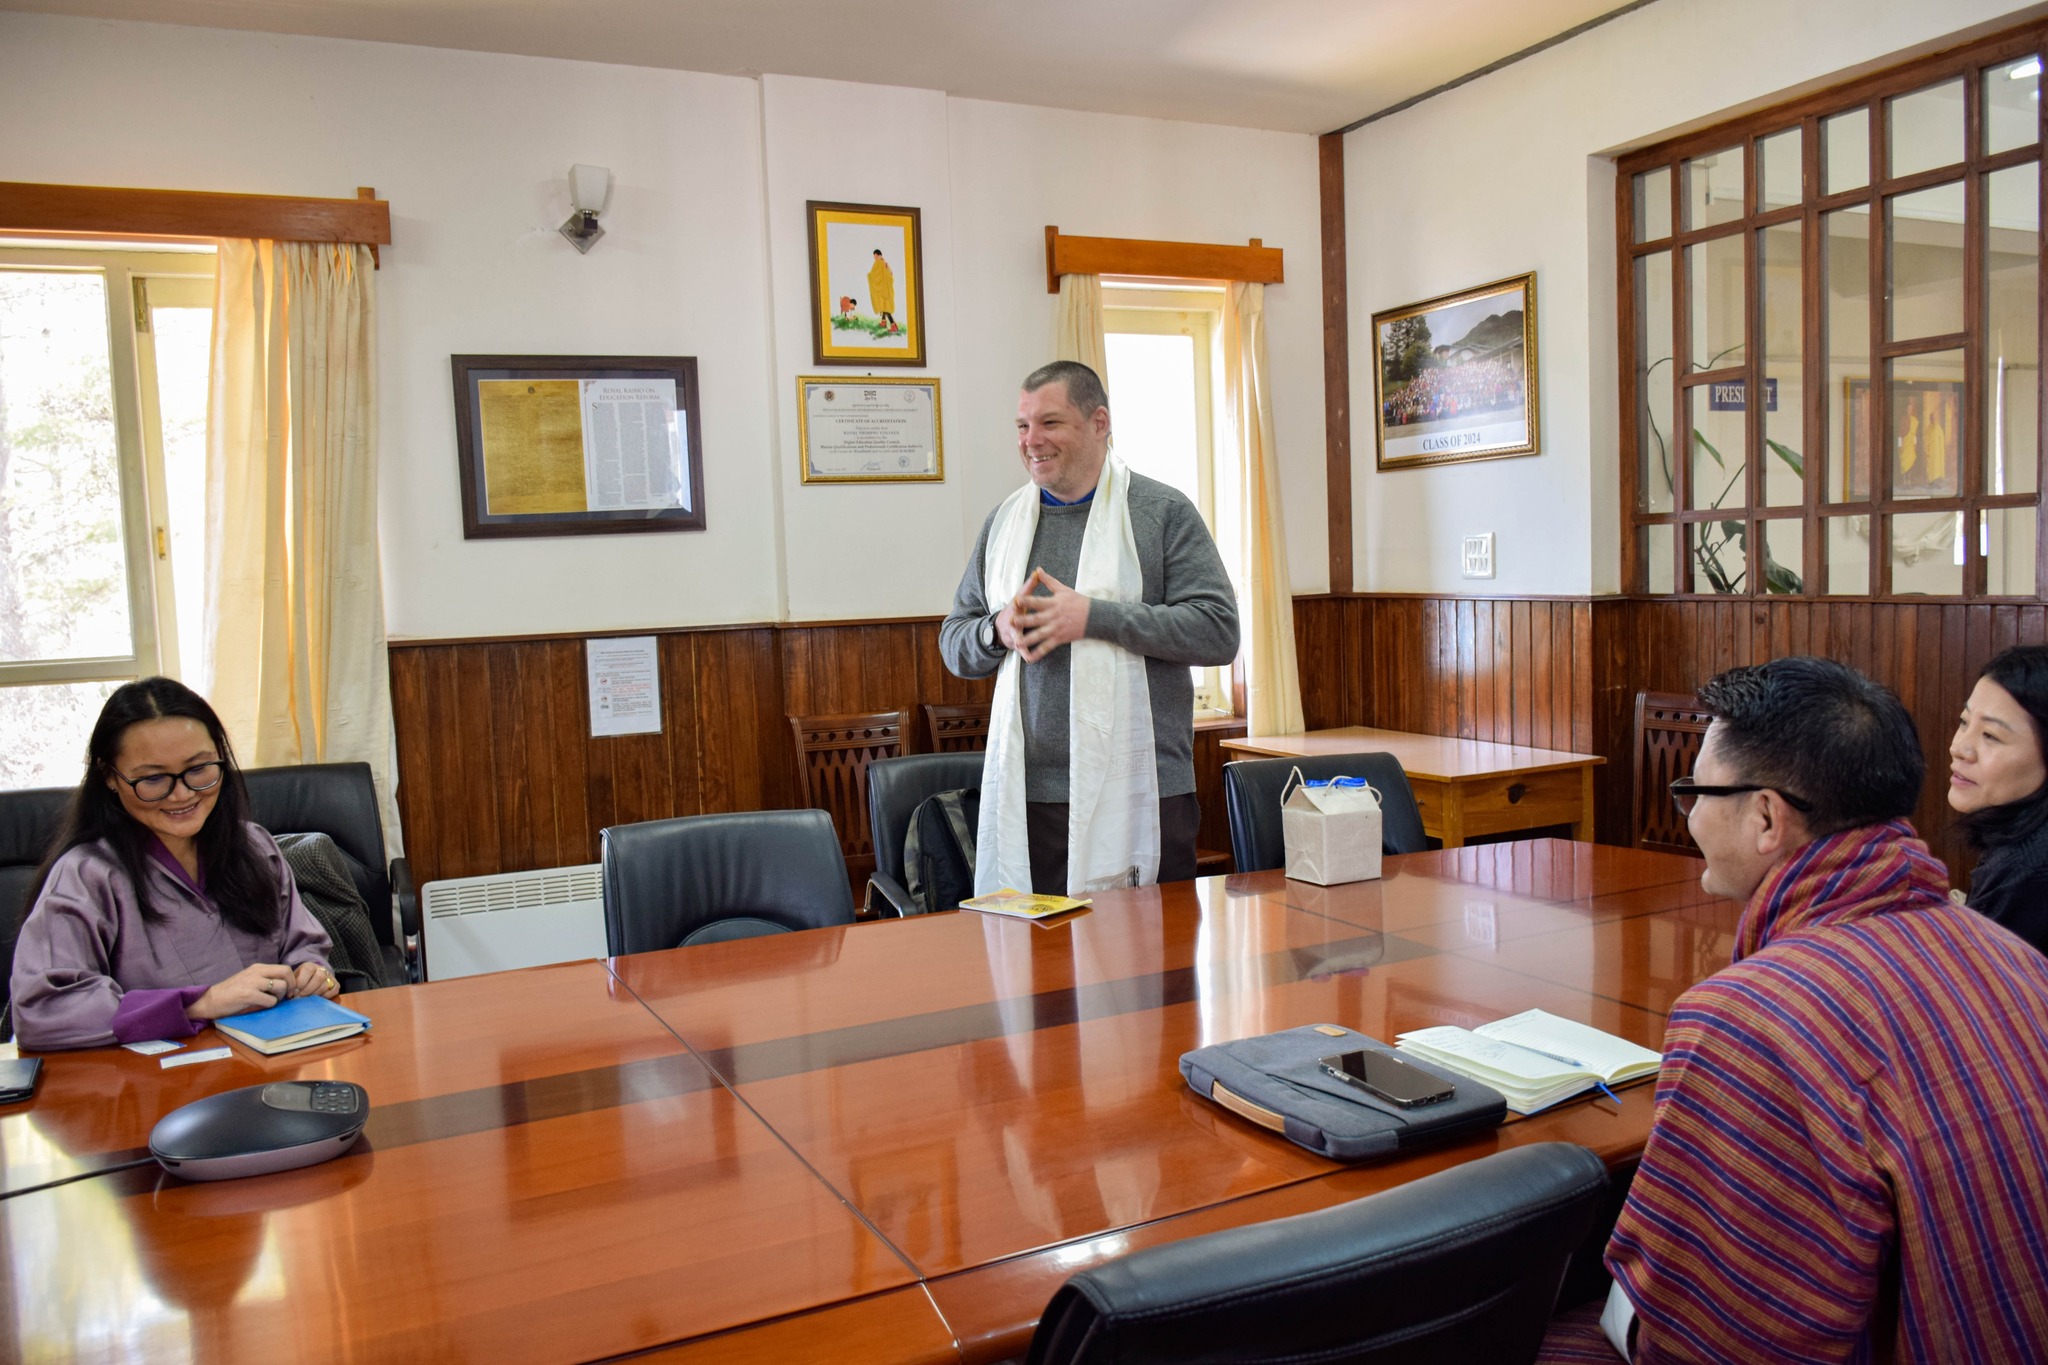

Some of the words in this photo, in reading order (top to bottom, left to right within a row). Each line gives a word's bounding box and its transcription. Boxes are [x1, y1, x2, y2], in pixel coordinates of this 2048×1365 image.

[1715, 385, 1772, 403] PRESIT
[1422, 437, 1449, 451] CLASS
[1450, 434, 1462, 447] OF
[1463, 432, 1481, 445] 2024
